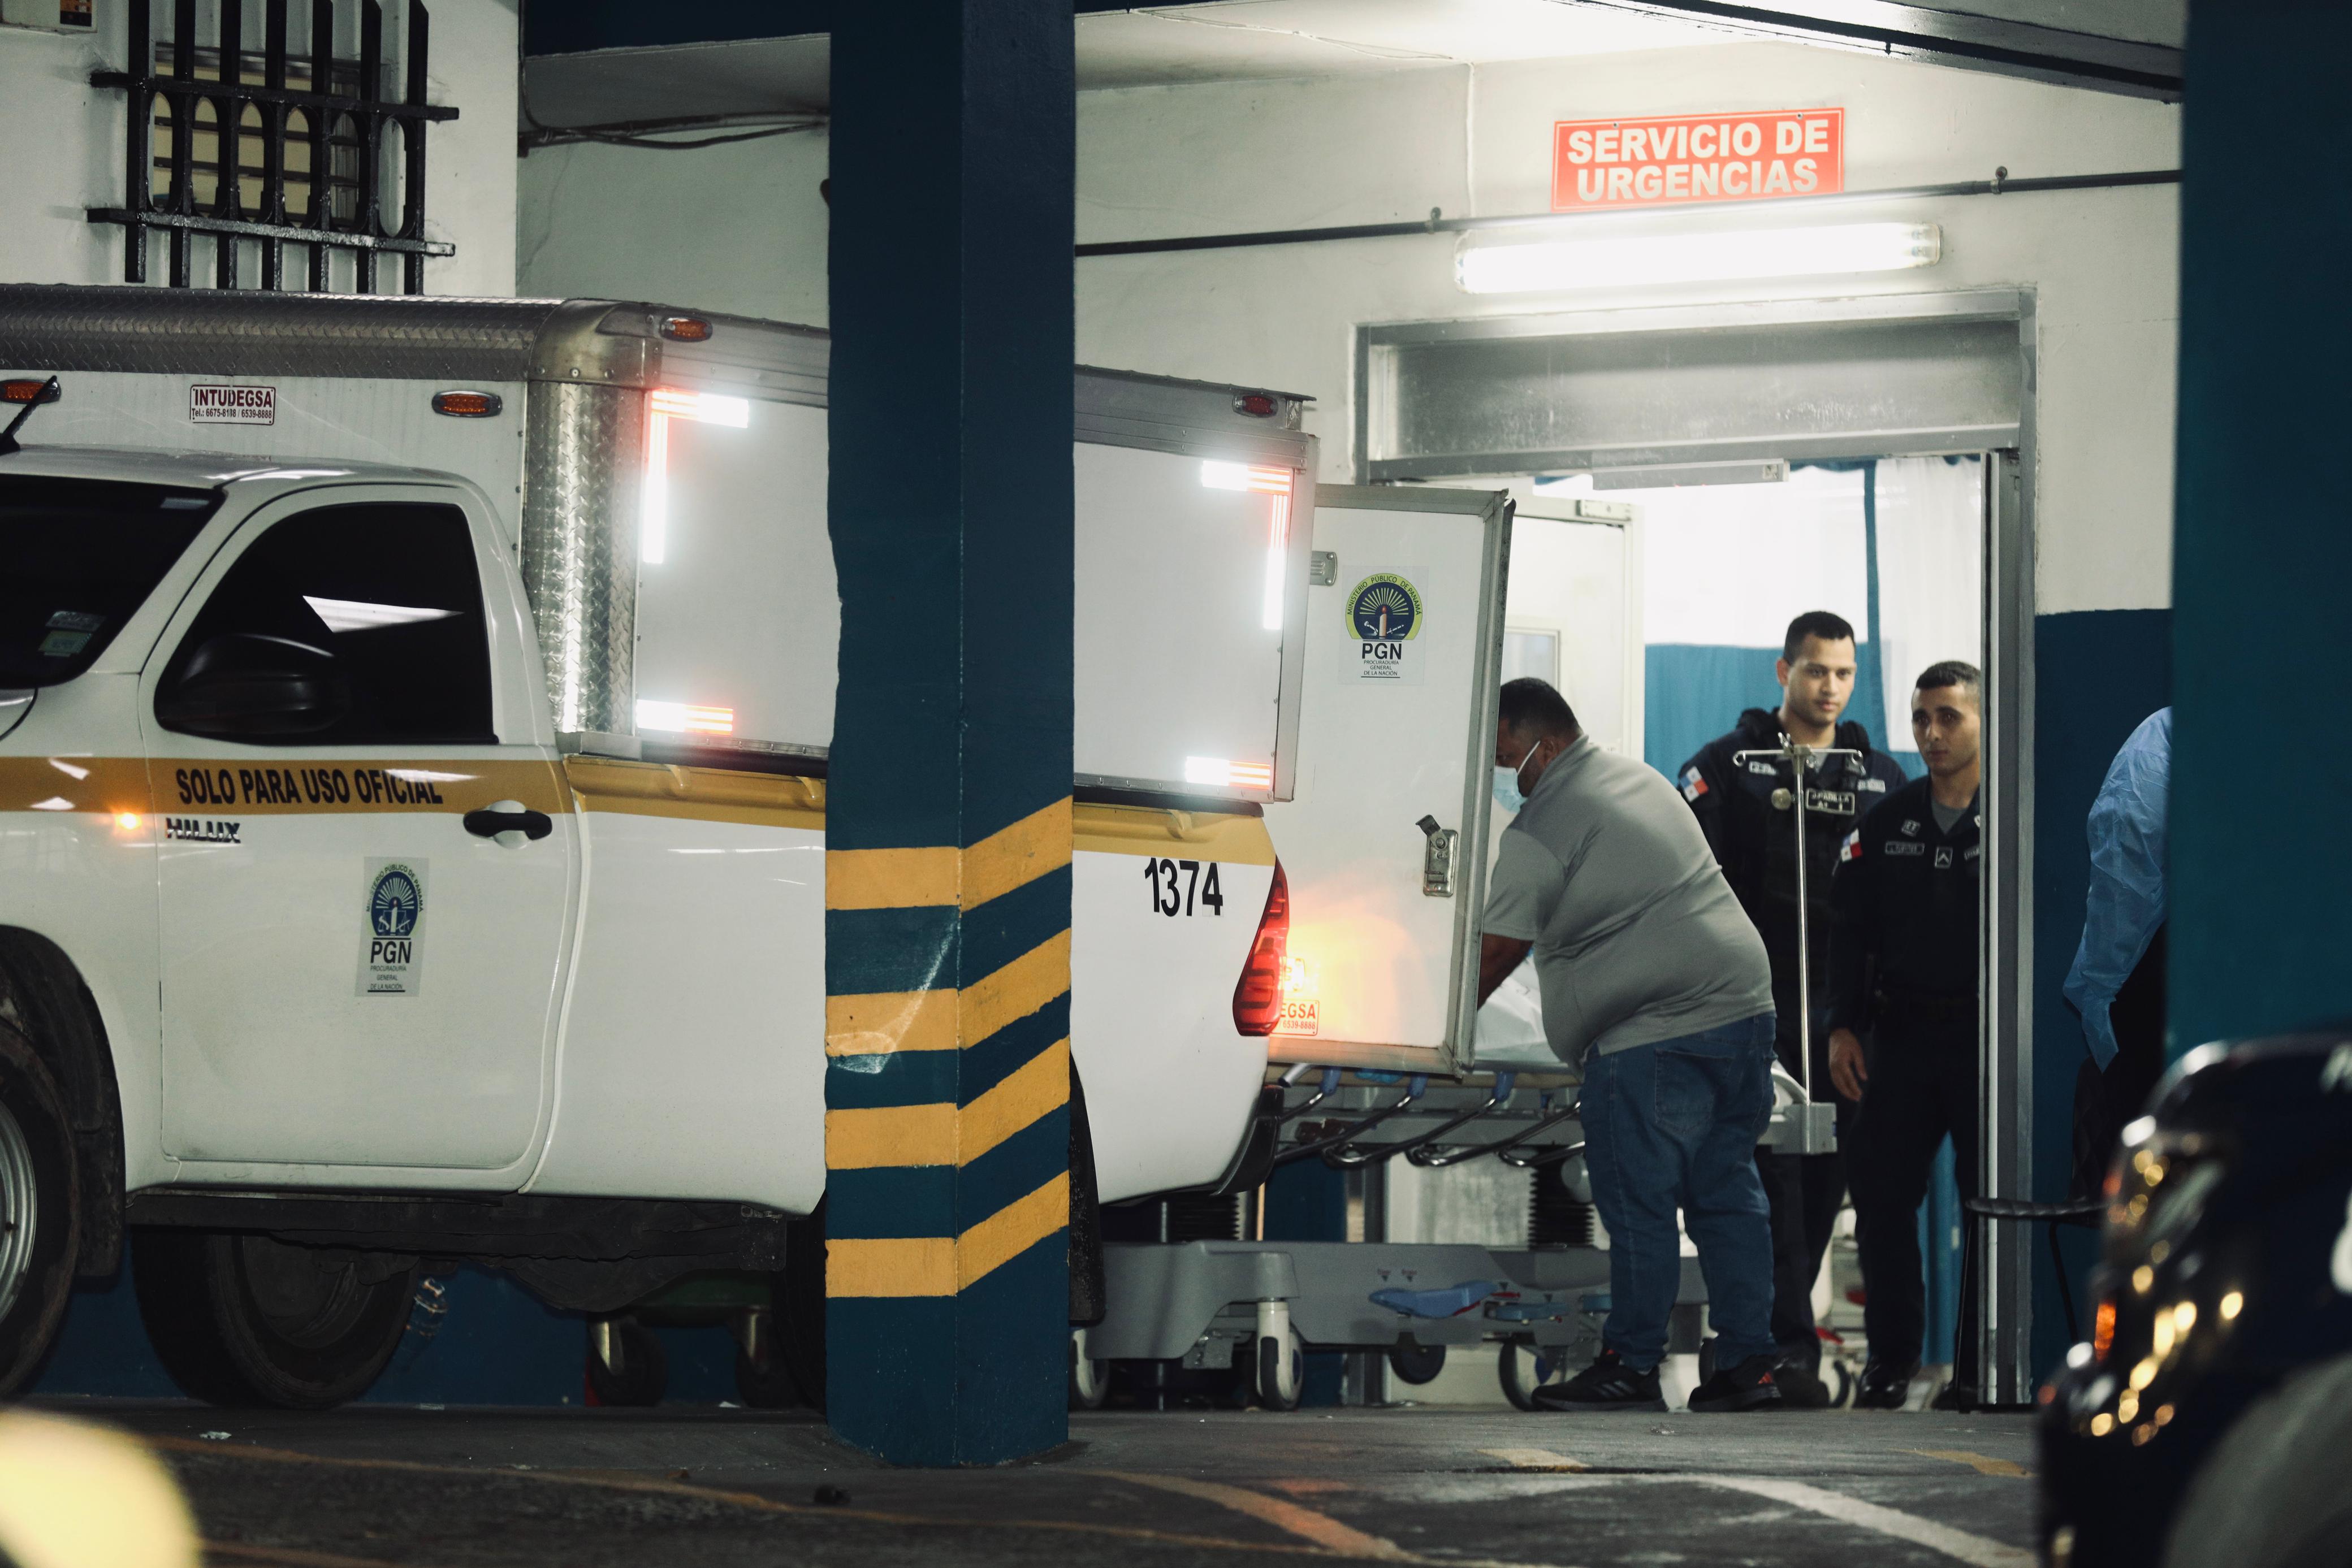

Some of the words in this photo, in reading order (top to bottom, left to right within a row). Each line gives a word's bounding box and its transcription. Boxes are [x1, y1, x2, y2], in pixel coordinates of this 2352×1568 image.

[1567, 122, 1762, 164] SERVICIO
[1776, 119, 1829, 154] DE
[1577, 158, 1818, 202] URGENCIAS
[194, 389, 273, 408] INTUDEGSA
[192, 408, 205, 417] Tel.:
[241, 409, 273, 419] 6539-8888
[1347, 581, 1368, 615] MINISTERIO
[1400, 581, 1409, 590] DE
[1361, 642, 1402, 660] PGN
[176, 769, 236, 805] SOLO
[239, 769, 302, 804] PARA
[300, 769, 351, 804] USO
[354, 769, 444, 804] OFICIAL
[166, 817, 241, 844] HILUX
[1144, 857, 1223, 917] 1374
[370, 941, 412, 964] PGN
[1280, 1003, 1316, 1019] EGSA
[1283, 1020, 1316, 1030] 6539-8888
